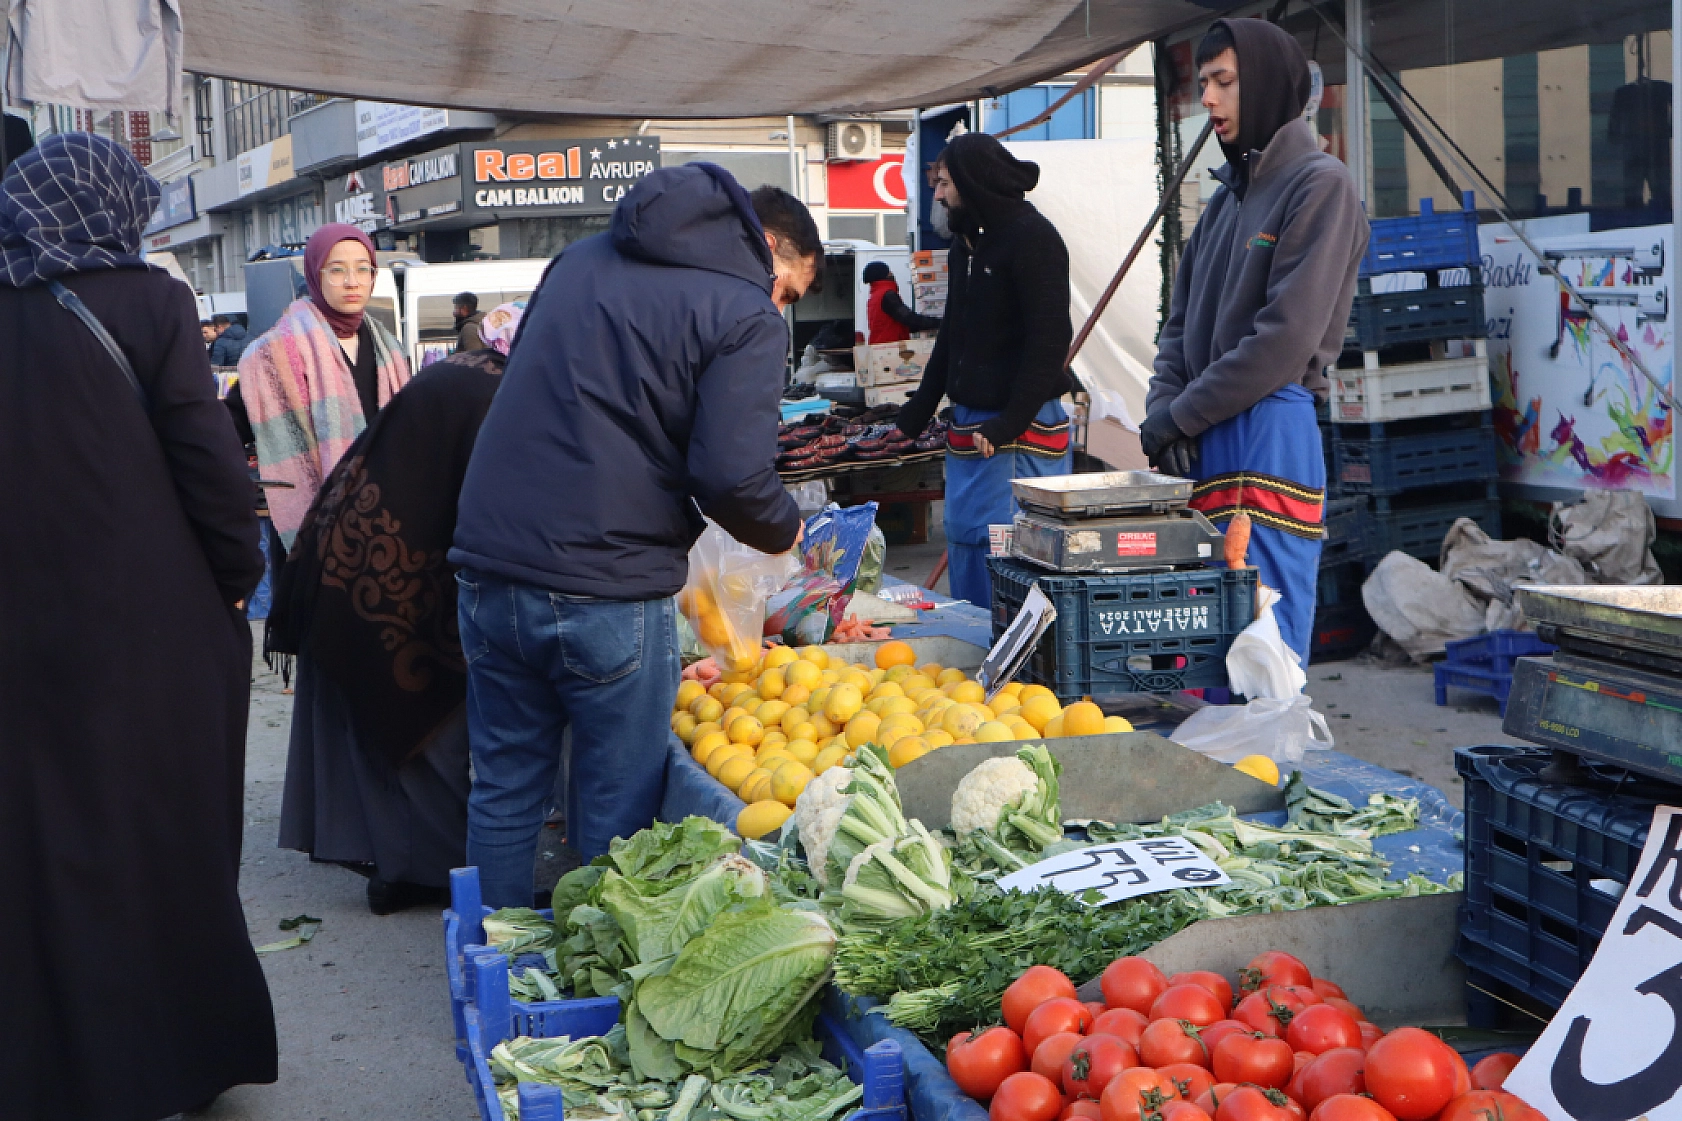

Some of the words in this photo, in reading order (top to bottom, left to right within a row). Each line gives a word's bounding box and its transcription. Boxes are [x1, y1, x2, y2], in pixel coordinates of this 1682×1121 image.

[473, 146, 581, 182] Real
[589, 161, 654, 179] AVRUPA
[383, 161, 409, 191] Real
[475, 187, 513, 207] CAM
[514, 185, 585, 205] BALKON
[1099, 611, 1130, 622] 2024
[1099, 614, 1208, 635] MALATYA
[1565, 727, 1580, 738] LCD
